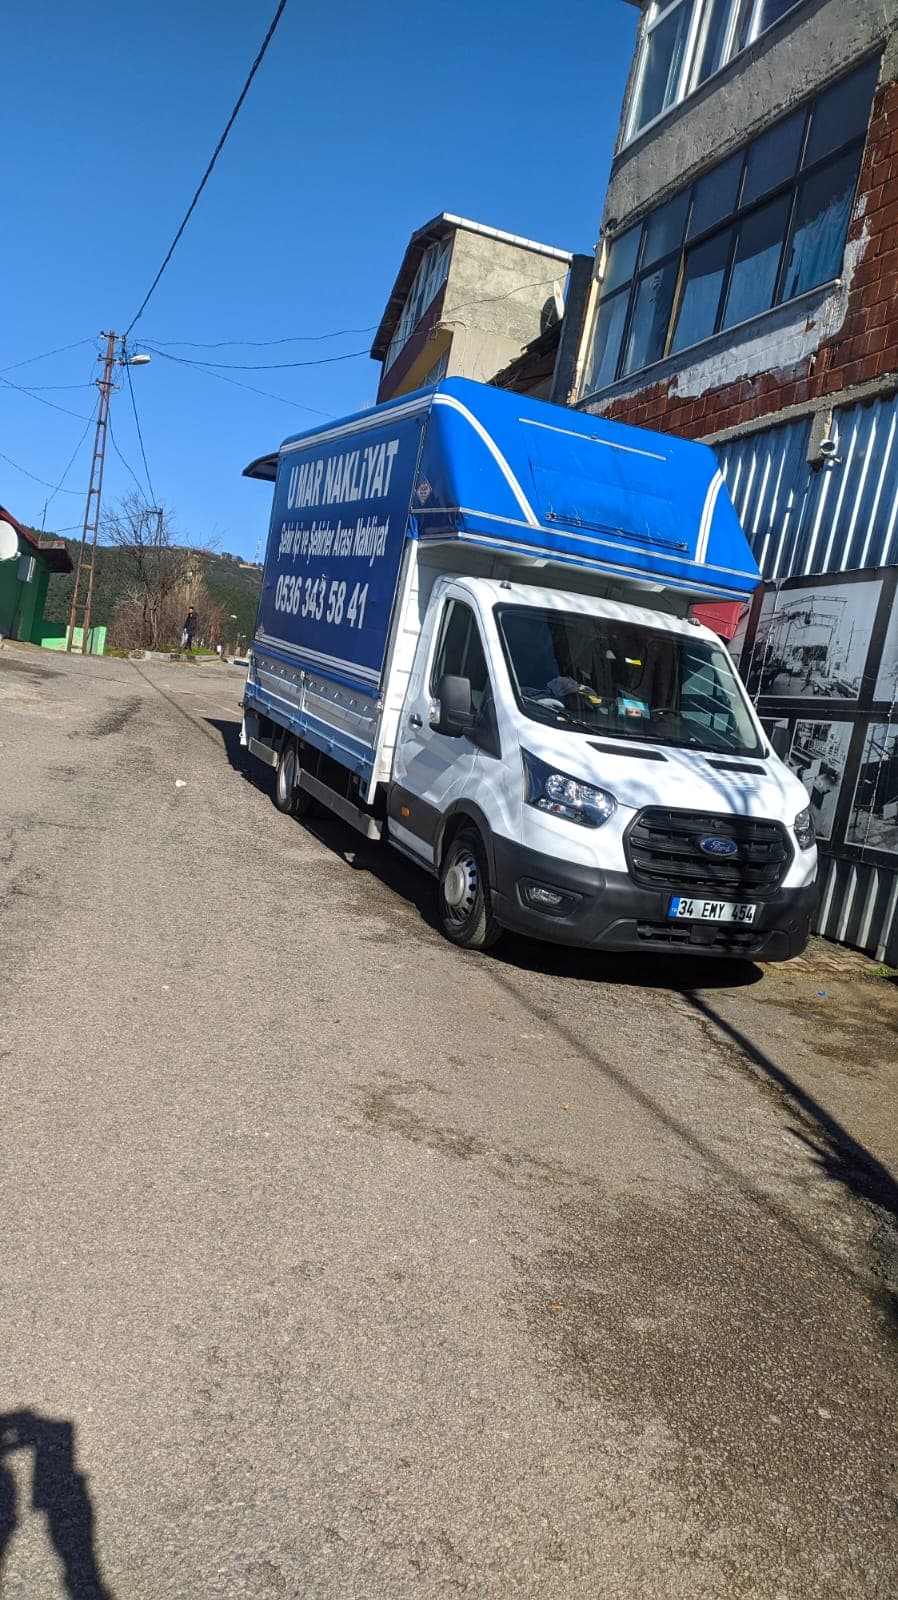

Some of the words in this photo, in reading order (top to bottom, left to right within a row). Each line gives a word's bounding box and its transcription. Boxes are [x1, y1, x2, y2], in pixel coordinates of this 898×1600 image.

[287, 460, 324, 509] UMAR
[332, 520, 355, 556] Arası
[352, 515, 390, 567] Nakliyat
[275, 574, 302, 615] 0536
[302, 577, 327, 620] 343
[326, 580, 347, 625] 58
[347, 582, 369, 629] 41
[678, 900, 694, 916] 34
[701, 902, 725, 918] EMY
[732, 904, 753, 921] 454
